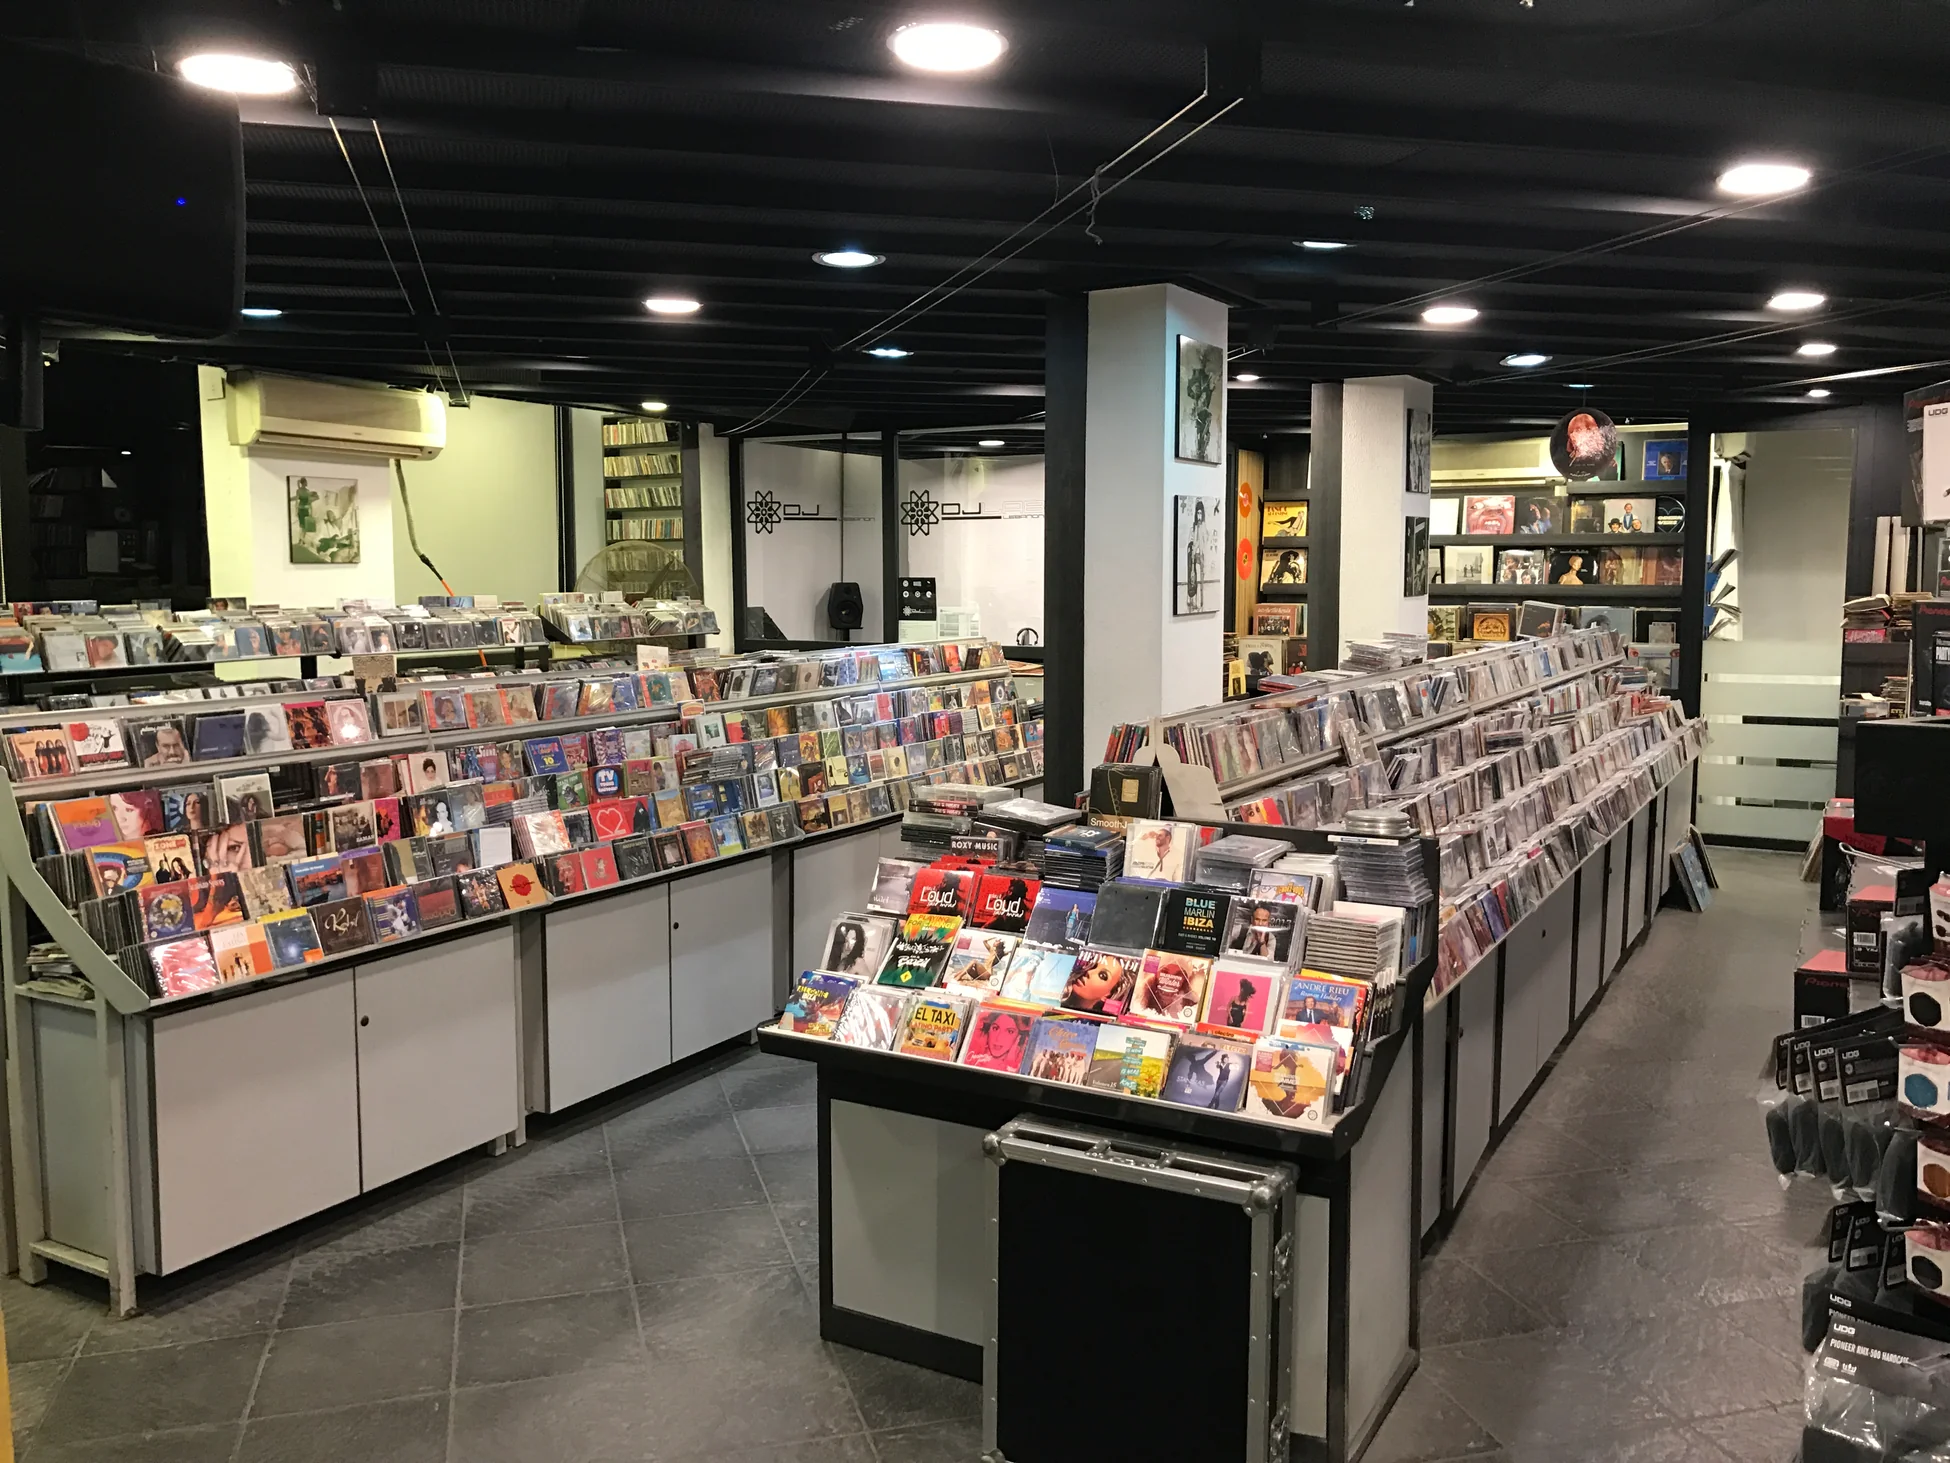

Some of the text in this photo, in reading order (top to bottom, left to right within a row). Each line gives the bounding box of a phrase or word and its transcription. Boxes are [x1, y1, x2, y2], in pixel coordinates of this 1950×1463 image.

[1928, 407, 1949, 417] UDG
[783, 504, 820, 516] DJ
[941, 502, 981, 515] DJ
[951, 841, 999, 850] ROXY MUSIC
[920, 886, 955, 904] Loud
[985, 893, 1022, 913] Loud
[1185, 897, 1216, 909] BLUE
[918, 914, 950, 922] PLAYING
[1183, 907, 1216, 919] MARLIN
[1183, 916, 1214, 929] IBIZA
[1295, 980, 1350, 996] ANDRÉ RIEU
[914, 1007, 956, 1026] EL TAXI
[910, 1022, 954, 1033] LATINO PARTY
[1814, 1047, 1835, 1057] UDG
[1842, 1050, 1860, 1060] UDG
[1829, 1294, 1852, 1307] UDG
[1833, 1323, 1856, 1335] UDG
[1829, 1338, 1856, 1353] PIONEER
[1856, 1345, 1881, 1360] RMX-500
